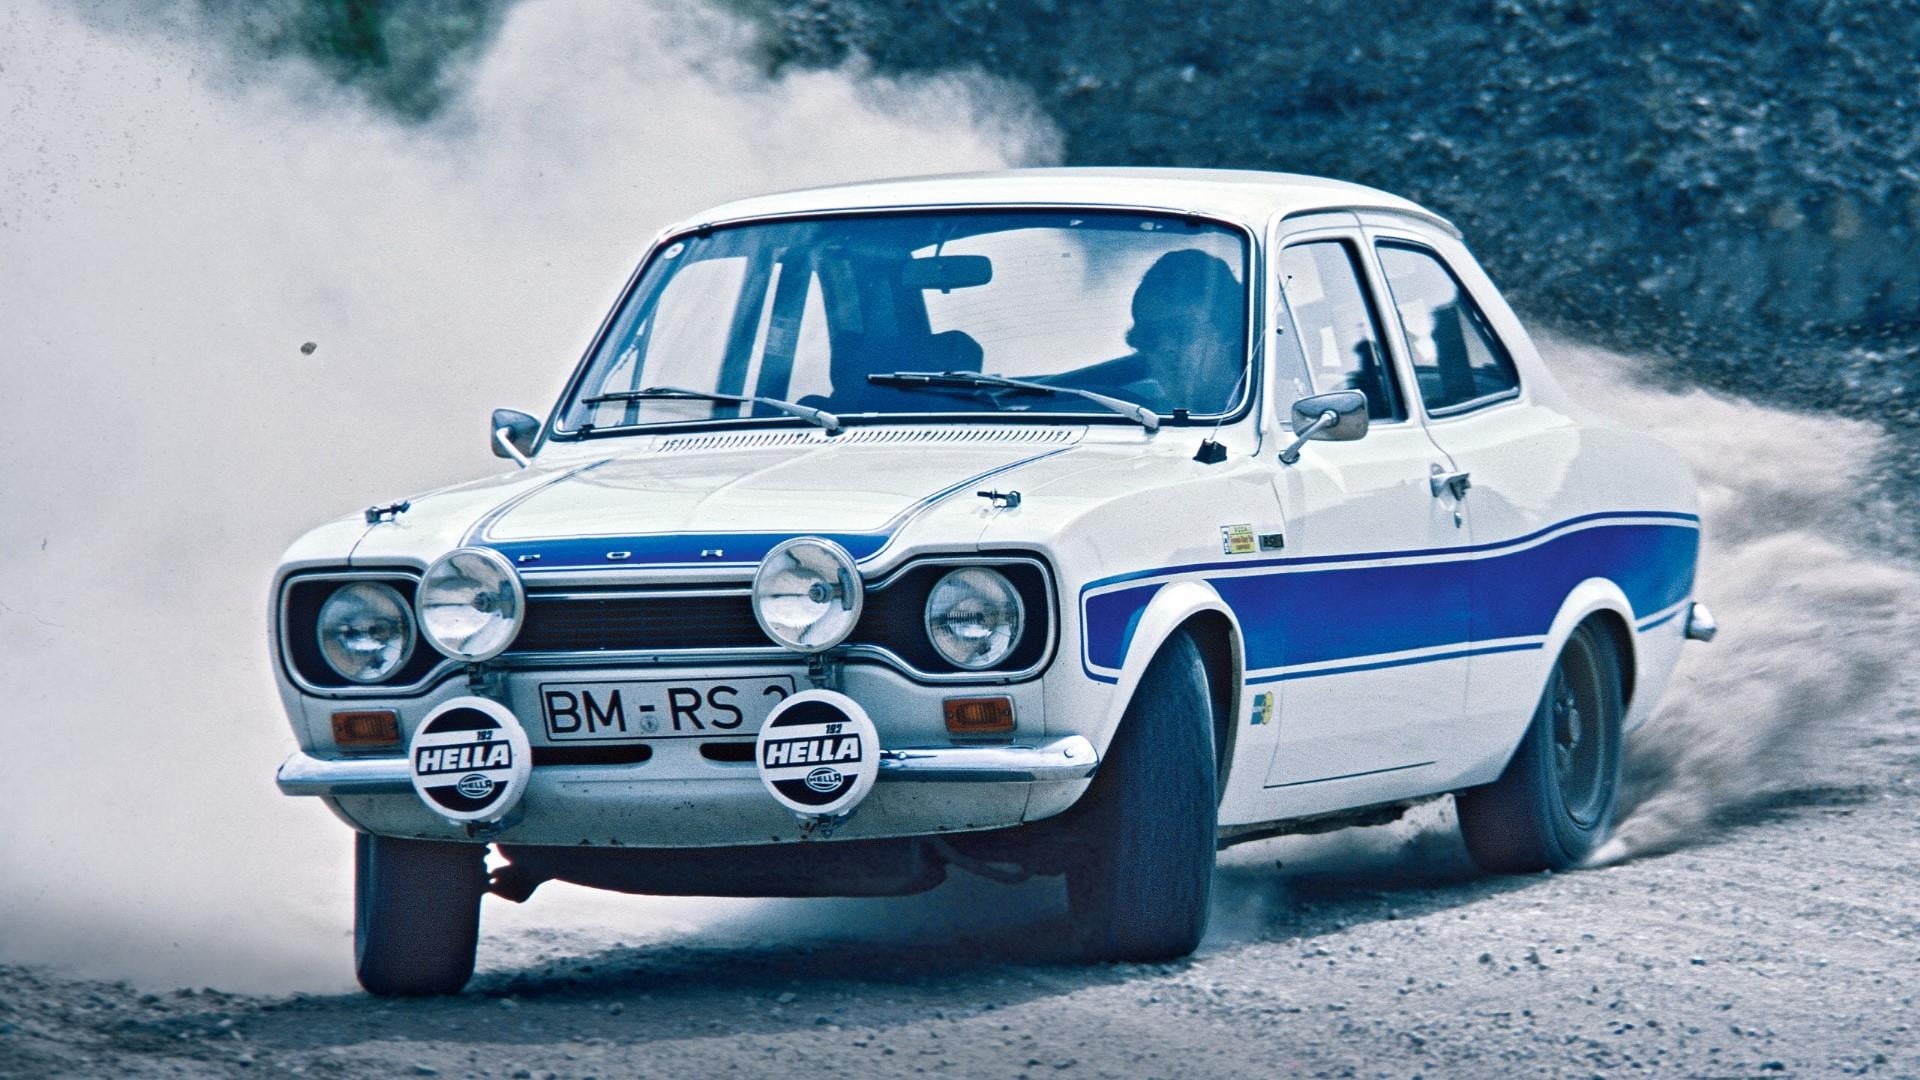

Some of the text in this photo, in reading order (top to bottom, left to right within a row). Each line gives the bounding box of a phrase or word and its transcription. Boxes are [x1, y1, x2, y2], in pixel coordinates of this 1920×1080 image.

[518, 549, 723, 562] FOR
[419, 744, 510, 772] HELLA
[766, 738, 859, 765] HELLA
[461, 779, 493, 789] HELLA
[809, 772, 842, 783] HELLA
